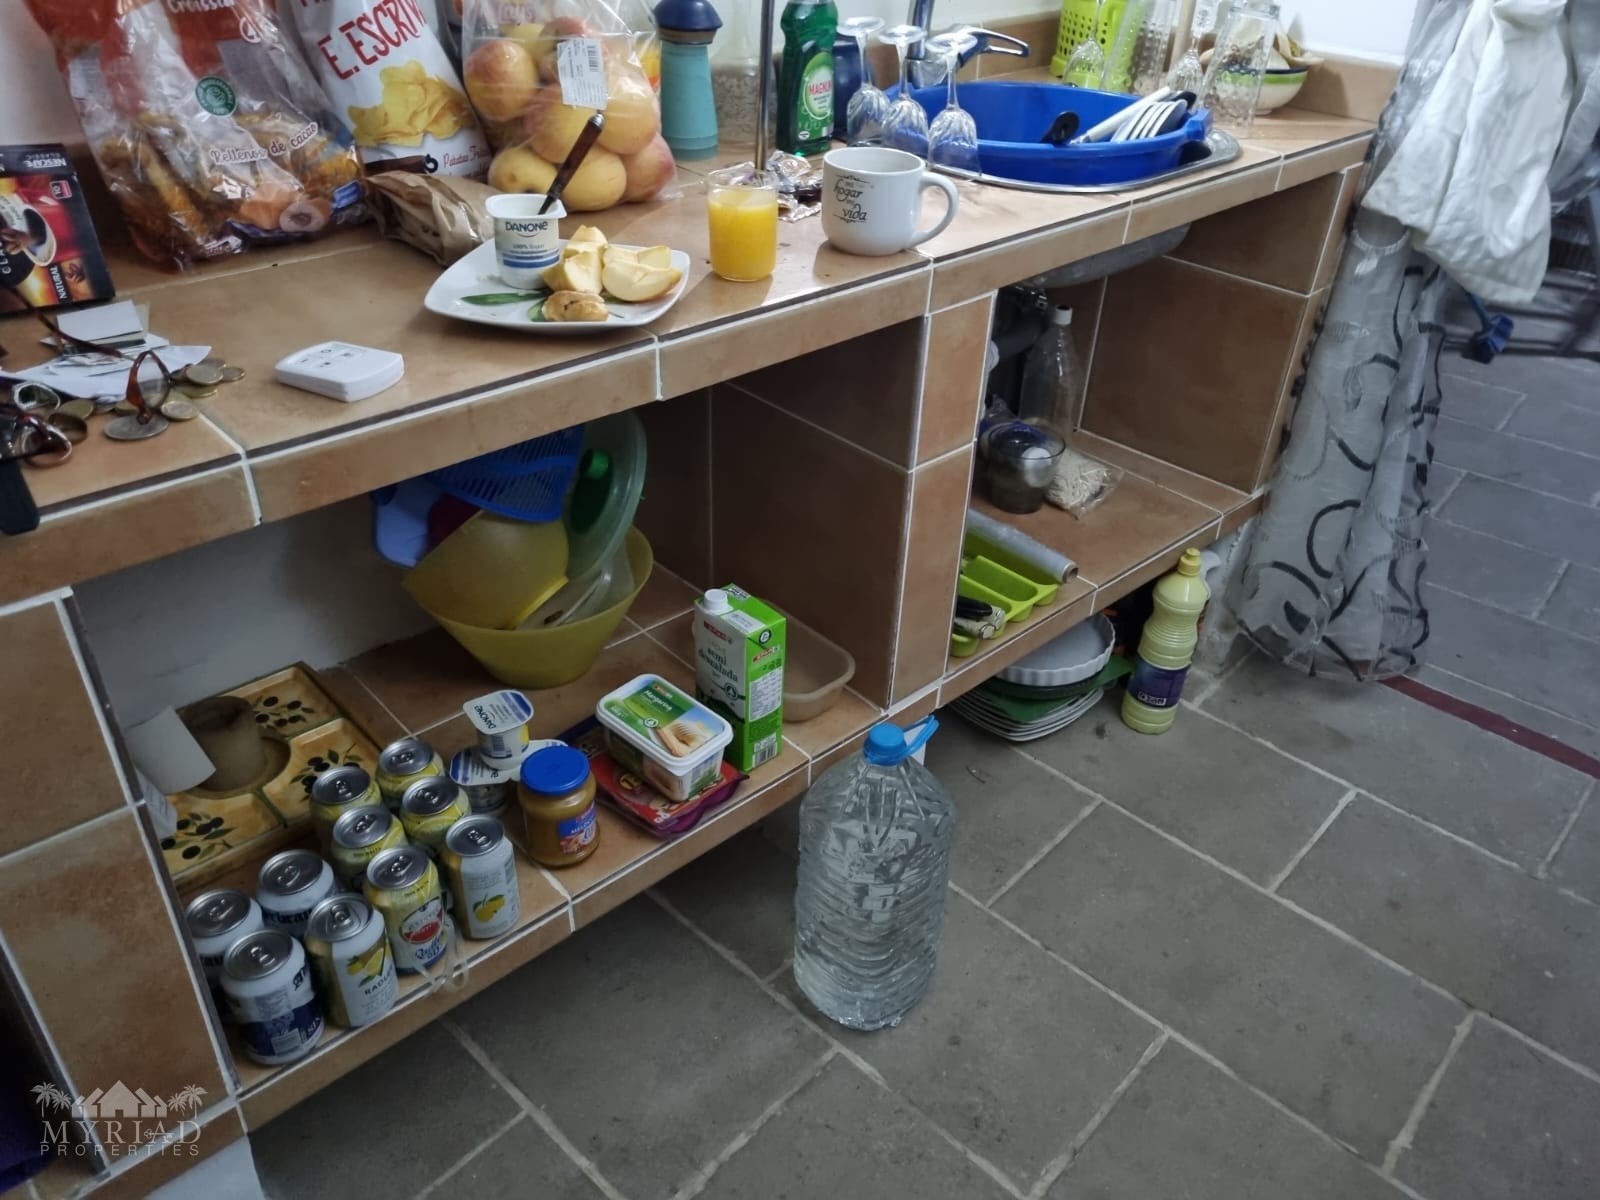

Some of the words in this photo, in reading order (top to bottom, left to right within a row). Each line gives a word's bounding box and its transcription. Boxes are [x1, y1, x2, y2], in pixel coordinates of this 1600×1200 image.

[210, 149, 265, 163] Rellenos
[270, 140, 286, 154] de
[290, 122, 318, 148] cacao
[842, 203, 868, 221] vida
[505, 221, 549, 232] DANONE
[50, 265, 67, 299] NATURAL
